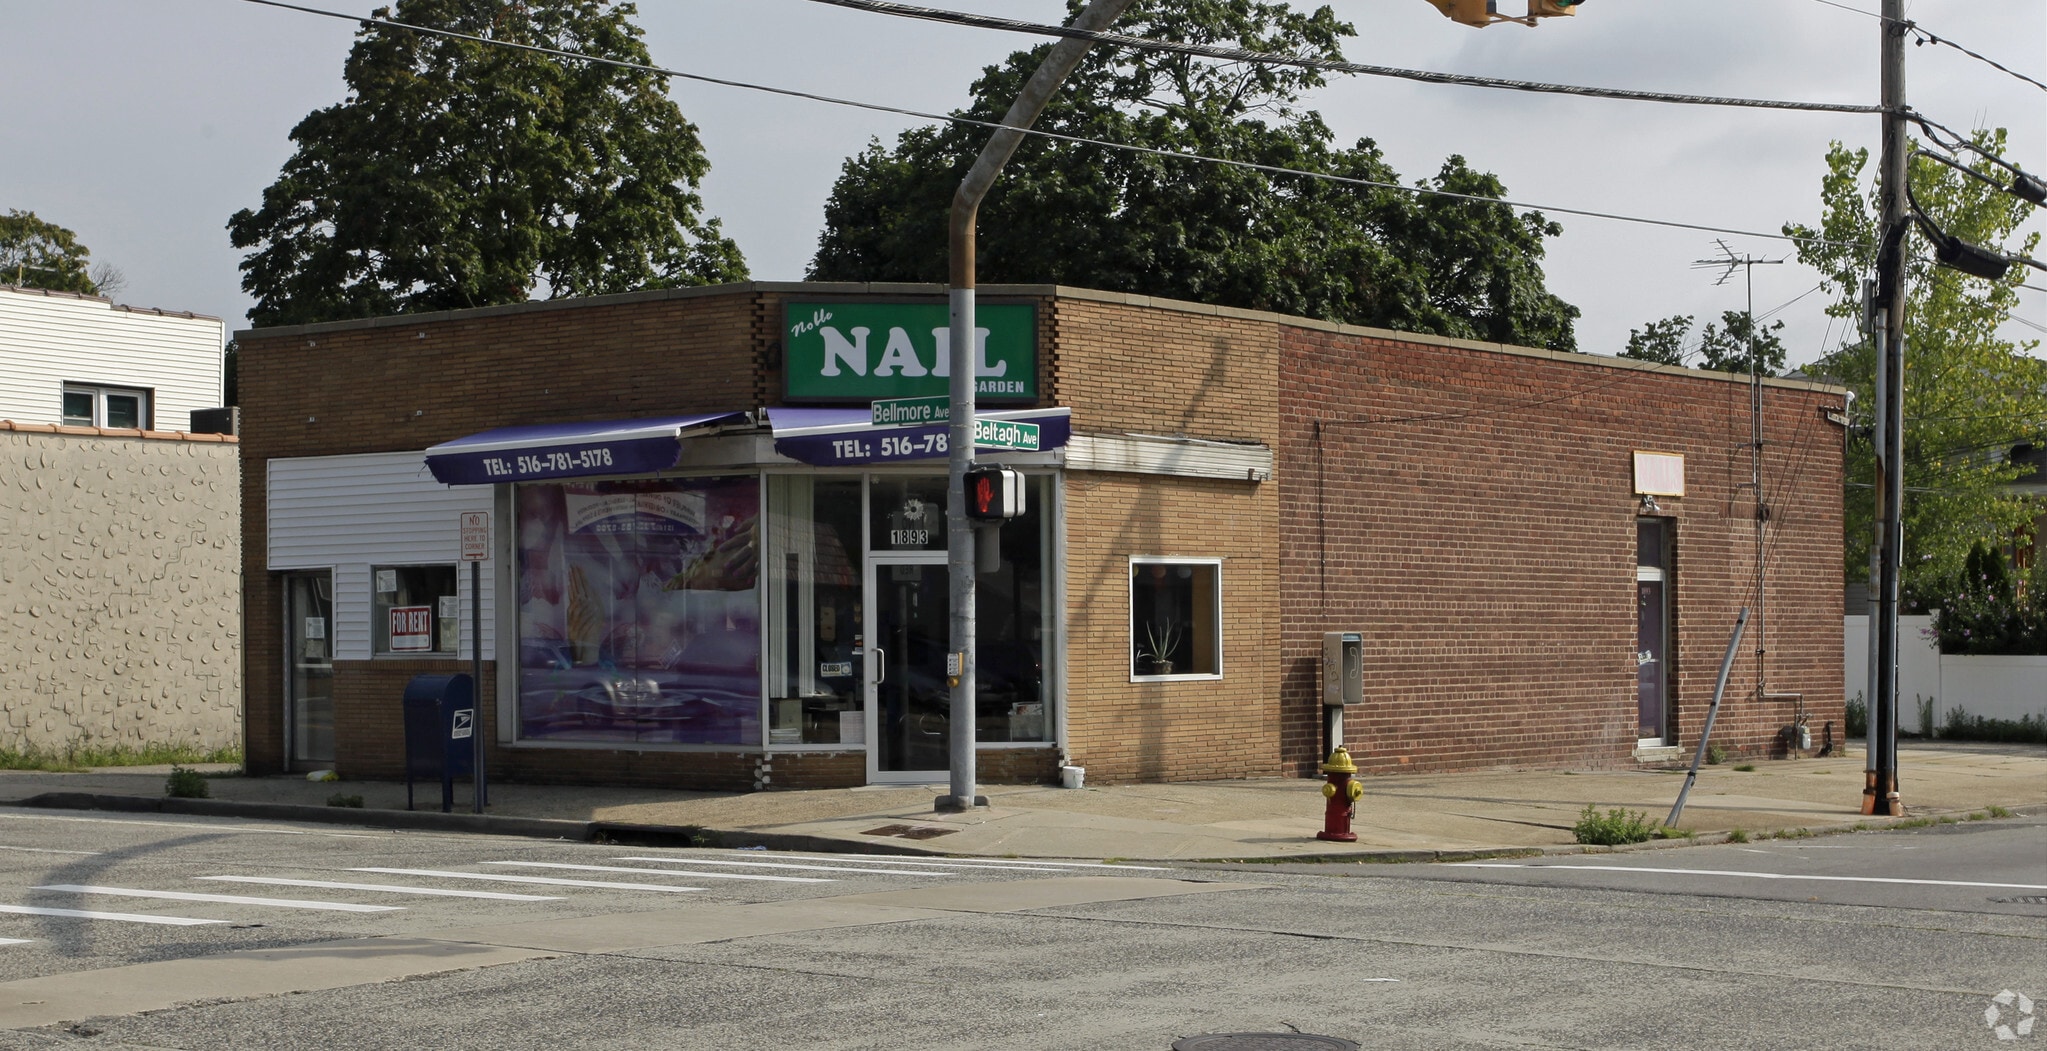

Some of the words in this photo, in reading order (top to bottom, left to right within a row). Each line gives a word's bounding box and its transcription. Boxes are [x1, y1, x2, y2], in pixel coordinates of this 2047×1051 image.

[791, 308, 833, 337] Noble
[819, 326, 1007, 377] NAIL
[873, 403, 931, 423] Bellmore
[934, 406, 950, 418] Ave
[832, 439, 871, 458] TEL:
[880, 432, 951, 456] 516-78
[974, 420, 1021, 446] Beltagh
[1022, 431, 1038, 445] Ave
[483, 458, 512, 476] TEL:
[517, 447, 613, 473] 516-781-5178
[469, 516, 480, 525] NO
[893, 530, 928, 544] 1893
[392, 612, 407, 633] FOR
[408, 611, 428, 632] RENT
